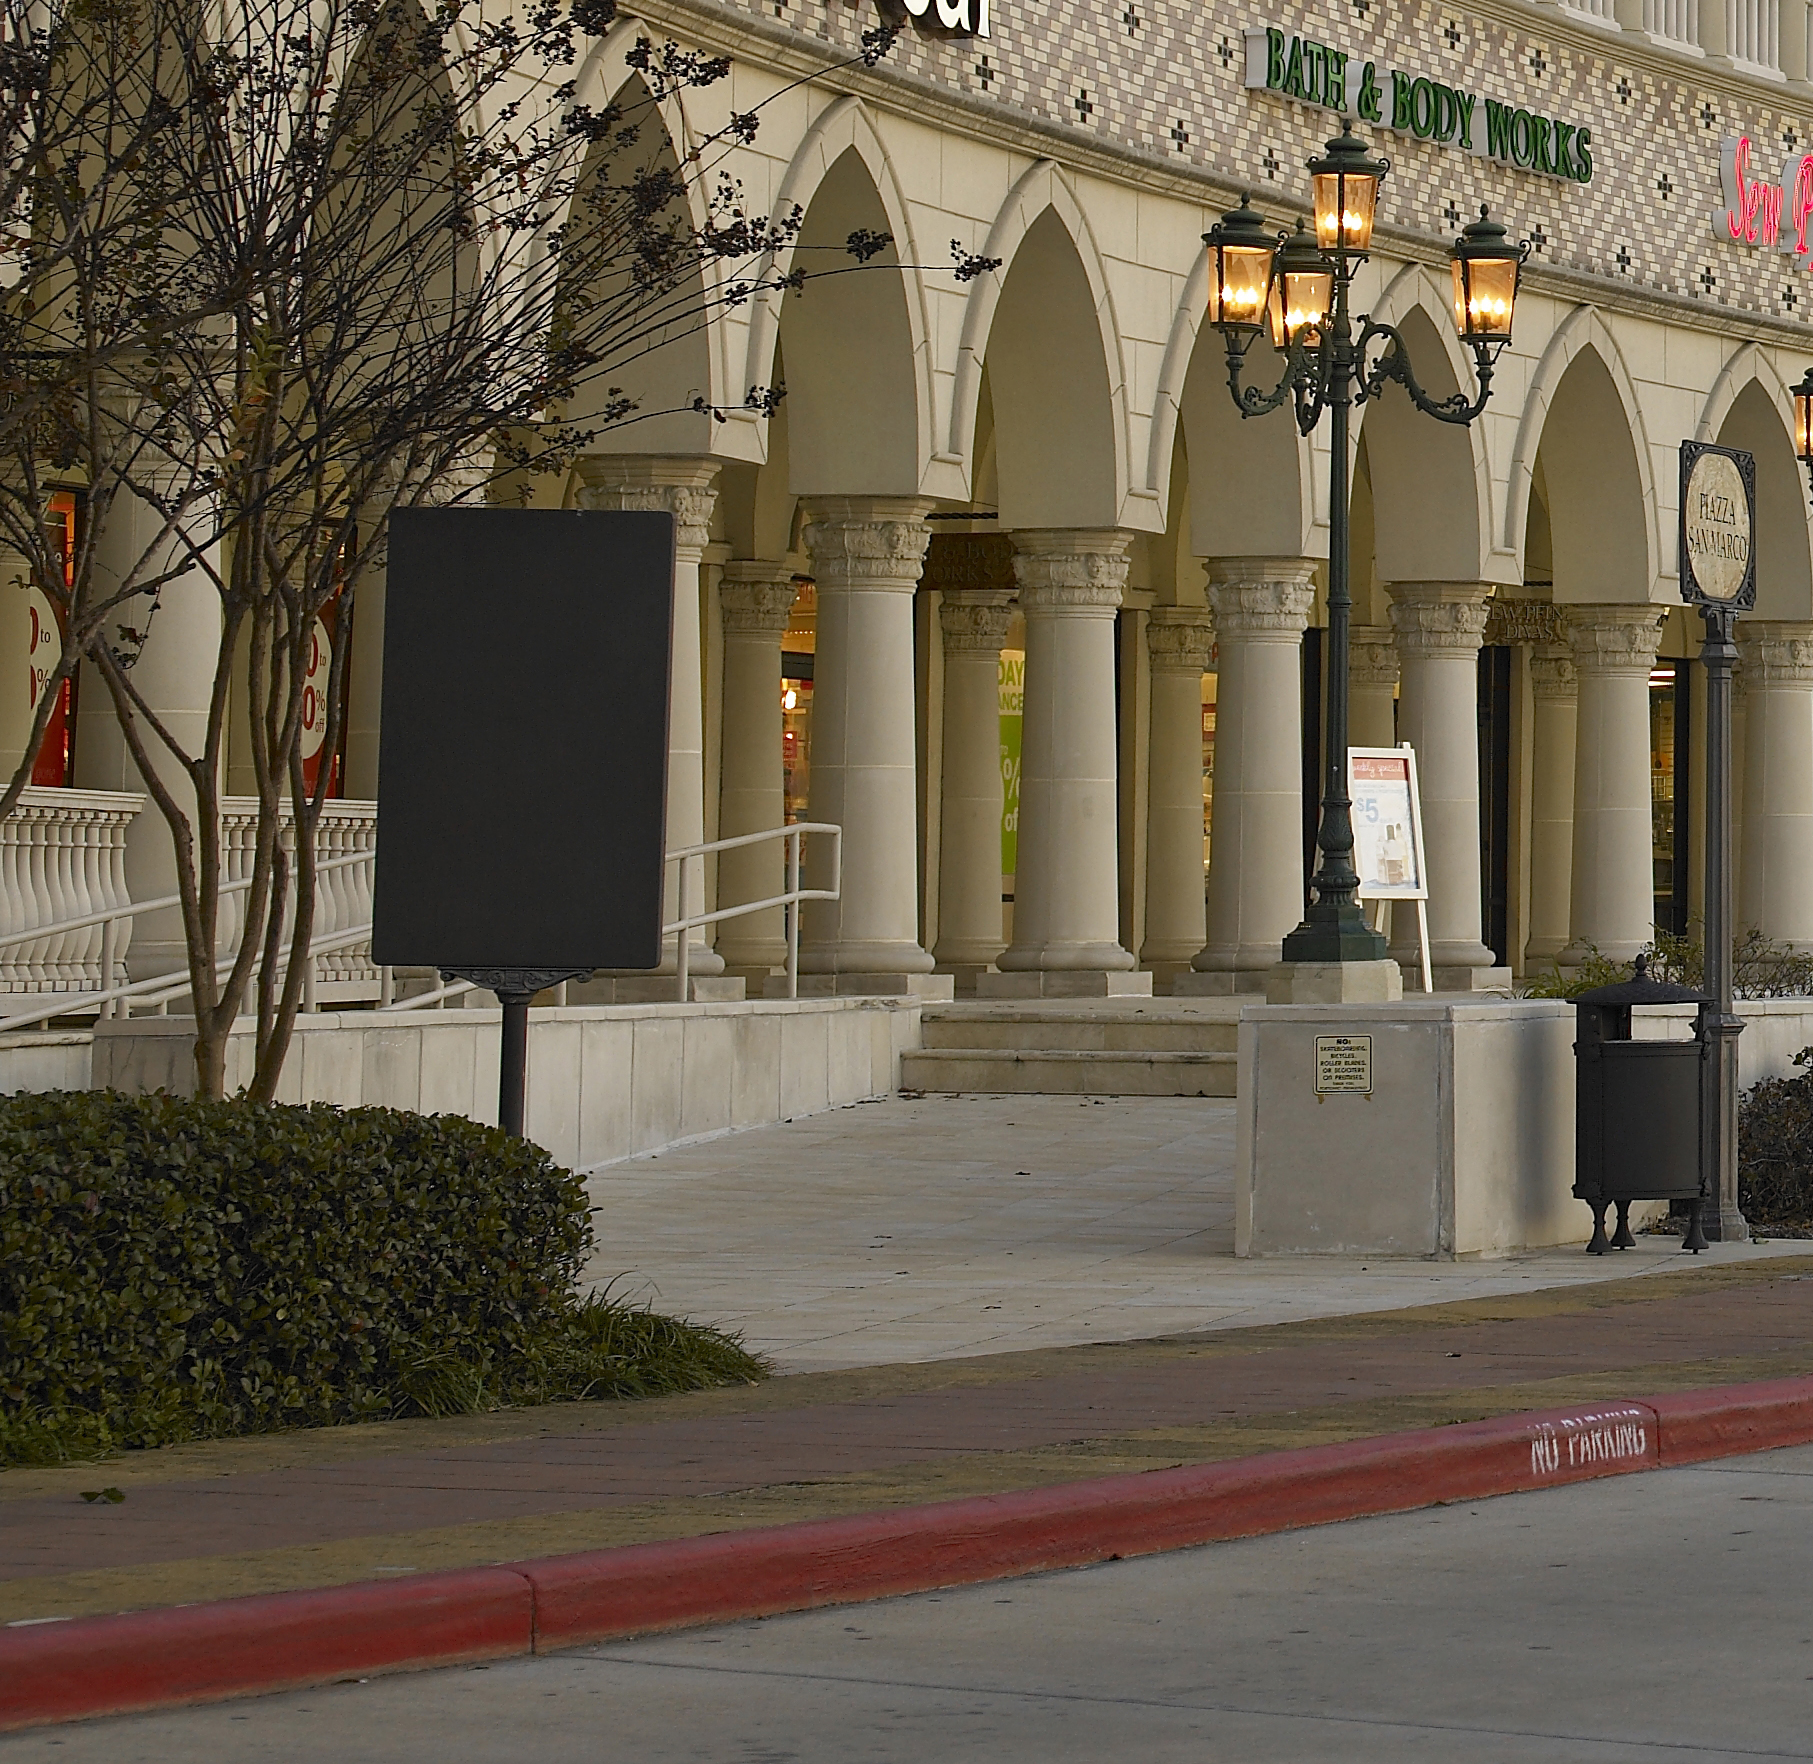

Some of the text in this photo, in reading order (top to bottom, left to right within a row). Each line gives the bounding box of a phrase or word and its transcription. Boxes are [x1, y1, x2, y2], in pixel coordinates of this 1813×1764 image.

[1266, 26, 1592, 183] BATH & BODY WORKS
[1728, 136, 1784, 247] Sew
[1699, 492, 1736, 526] PIAZZA
[965, 542, 1014, 560] BOD
[1688, 526, 1747, 562] SAN MARCO
[1491, 605, 1564, 620] EW PFIN
[40, 628, 51, 644] to
[1505, 624, 1553, 639] DIVAS
[319, 652, 327, 667] to
[1004, 806, 1019, 832] of
[1356, 797, 1379, 824] $5
[1528, 1409, 1646, 1475] NO PARKING
